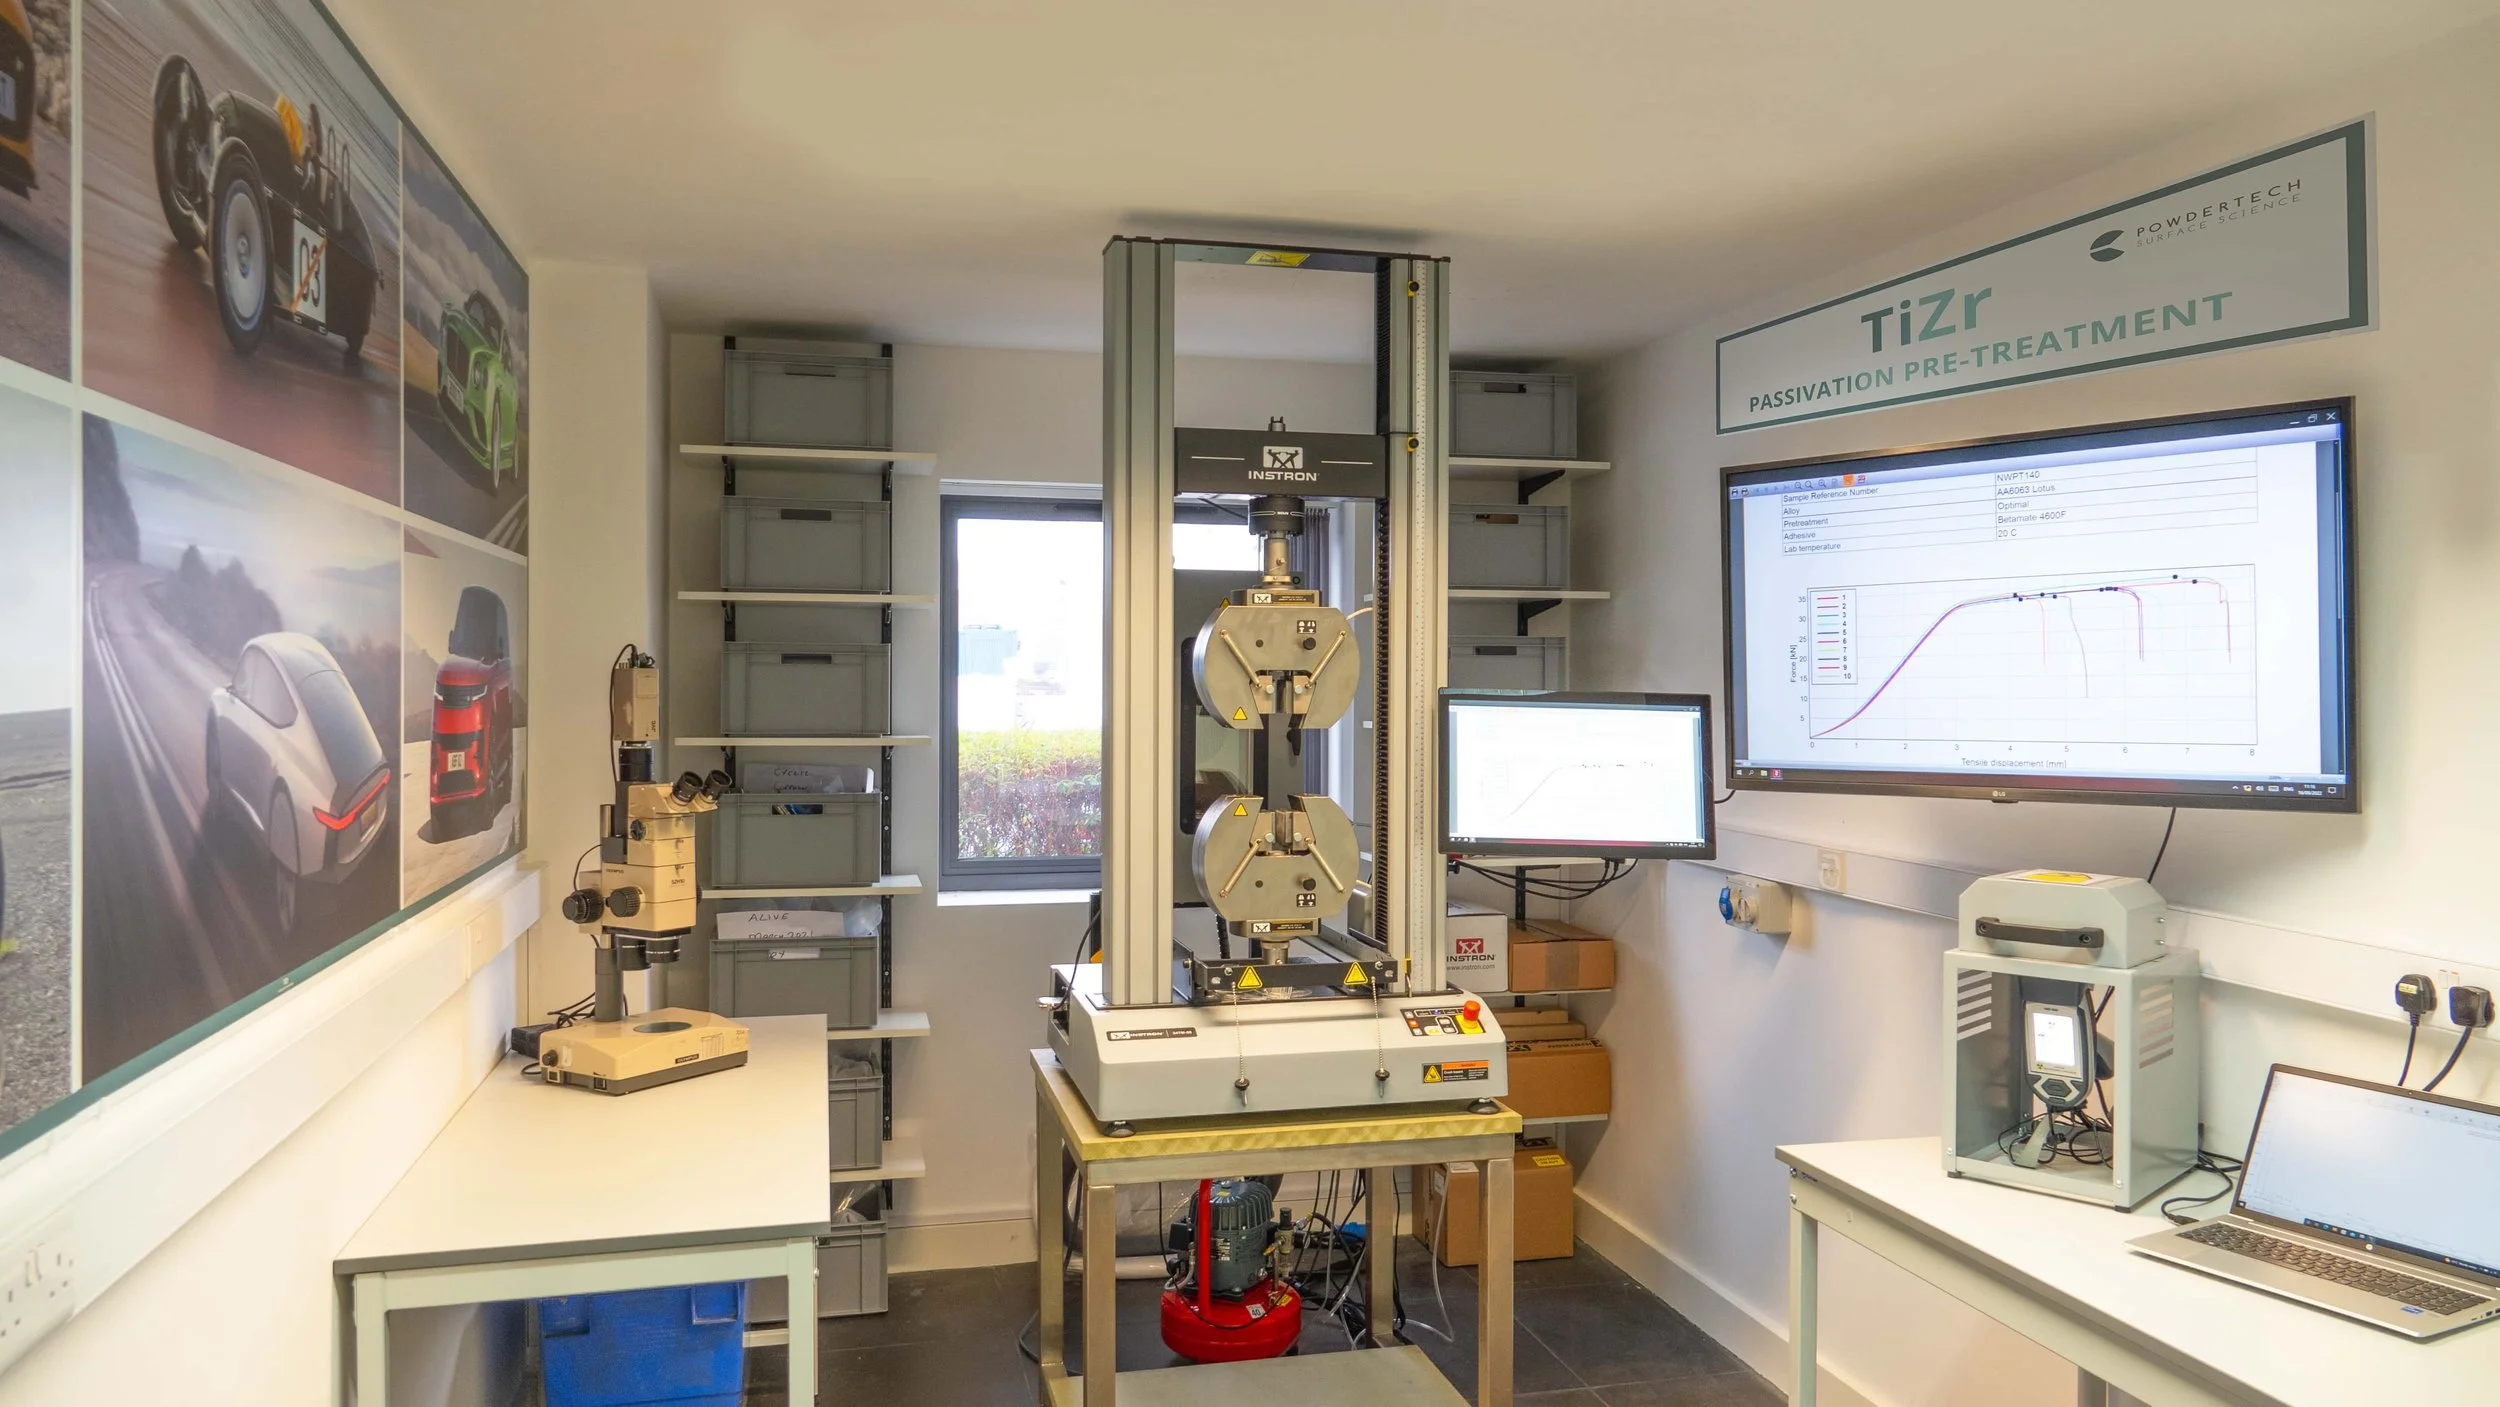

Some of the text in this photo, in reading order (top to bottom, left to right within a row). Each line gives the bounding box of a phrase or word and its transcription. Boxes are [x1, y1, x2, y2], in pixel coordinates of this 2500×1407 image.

[2136, 178, 2301, 238] POWDERTECH
[2136, 193, 2301, 248] SURFACE SCIENCE
[1860, 286, 1993, 354] TiZr
[1749, 291, 2234, 413] PASSIVATION PRE-TREATMENT
[1247, 470, 1317, 481] INSTRON
[1997, 470, 2041, 482] NWPT140
[1783, 487, 1880, 503] Sample Reference Number
[1997, 484, 2056, 496] AA6063 Lotus
[1997, 500, 2030, 511] Optimal
[1783, 507, 1801, 516] Alloy
[1783, 518, 1829, 528] Pretreatment
[1997, 514, 2038, 524] Betamate
[1783, 531, 1816, 541] Adhesive
[1997, 529, 2009, 538] 20
[1784, 542, 1842, 553] Lab temperature
[1789, 660, 1797, 683] Force
[1961, 757, 1989, 767] Tensile
[1990, 758, 2044, 769] displacement
[748, 913, 790, 922] ALIVE
[1446, 954, 1495, 963] INSTRON
[1251, 1307, 1261, 1316] 40
